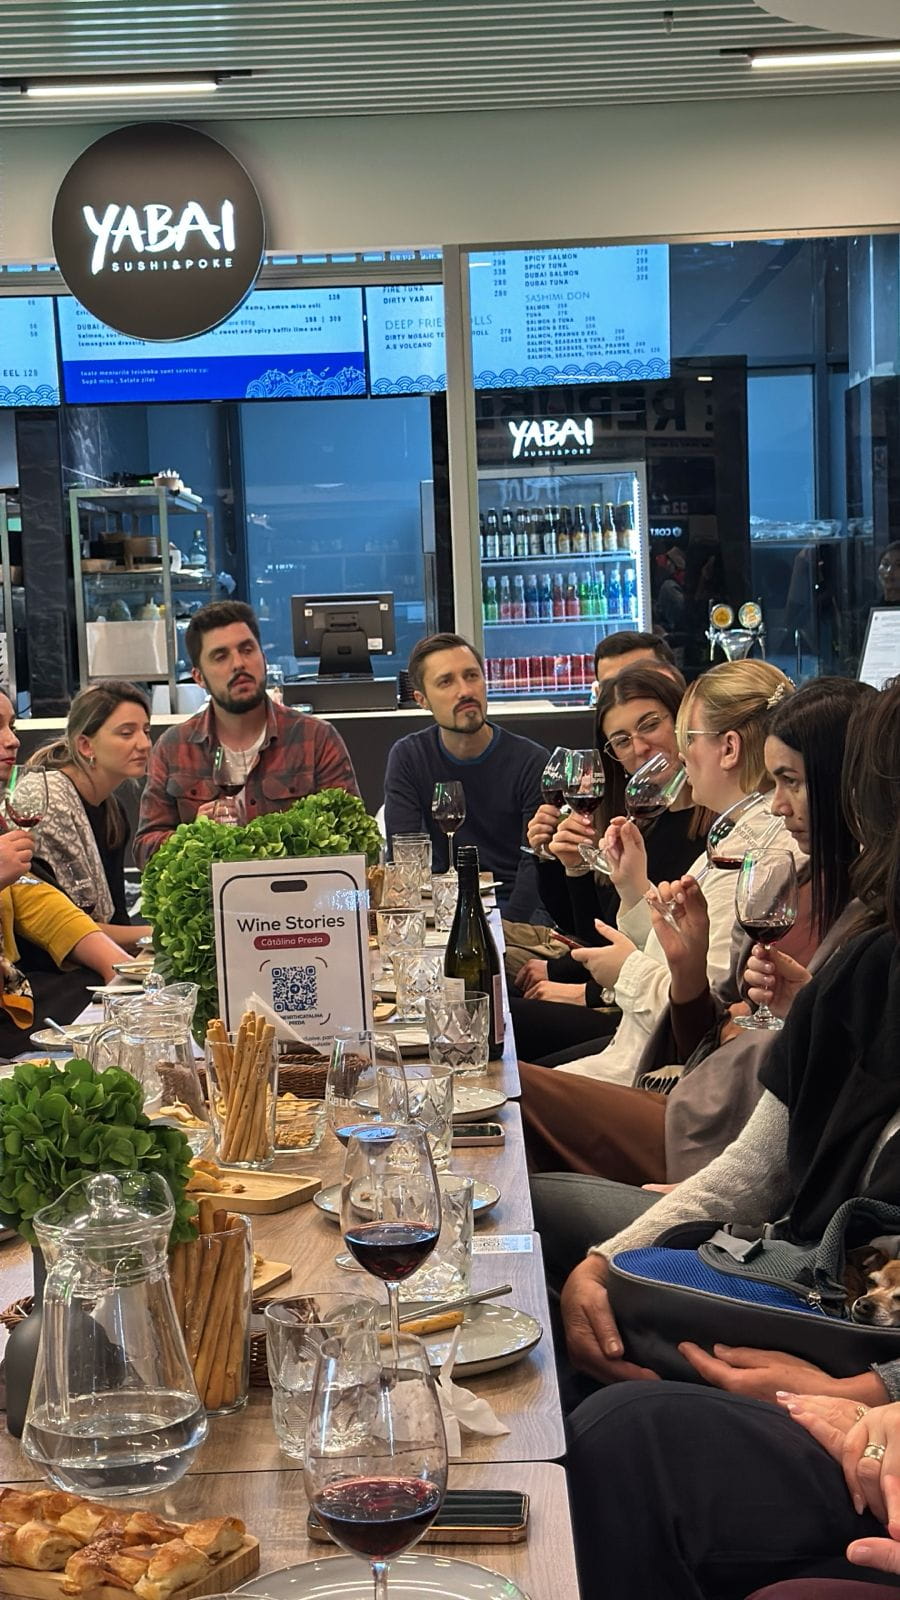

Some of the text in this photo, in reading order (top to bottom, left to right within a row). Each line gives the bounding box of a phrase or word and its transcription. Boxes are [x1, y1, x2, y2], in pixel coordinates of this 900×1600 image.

[82, 199, 235, 275] YABAI
[547, 253, 578, 261] SALMON
[112, 258, 233, 272] SUSHI&POKE
[524, 263, 546, 271] SPICY
[566, 291, 590, 301] DON
[385, 319, 414, 331] DEEP
[3, 369, 20, 377] EEL
[508, 417, 594, 459] YABAI
[237, 914, 346, 932] Wine Stories
[298, 935, 323, 945] Preda
